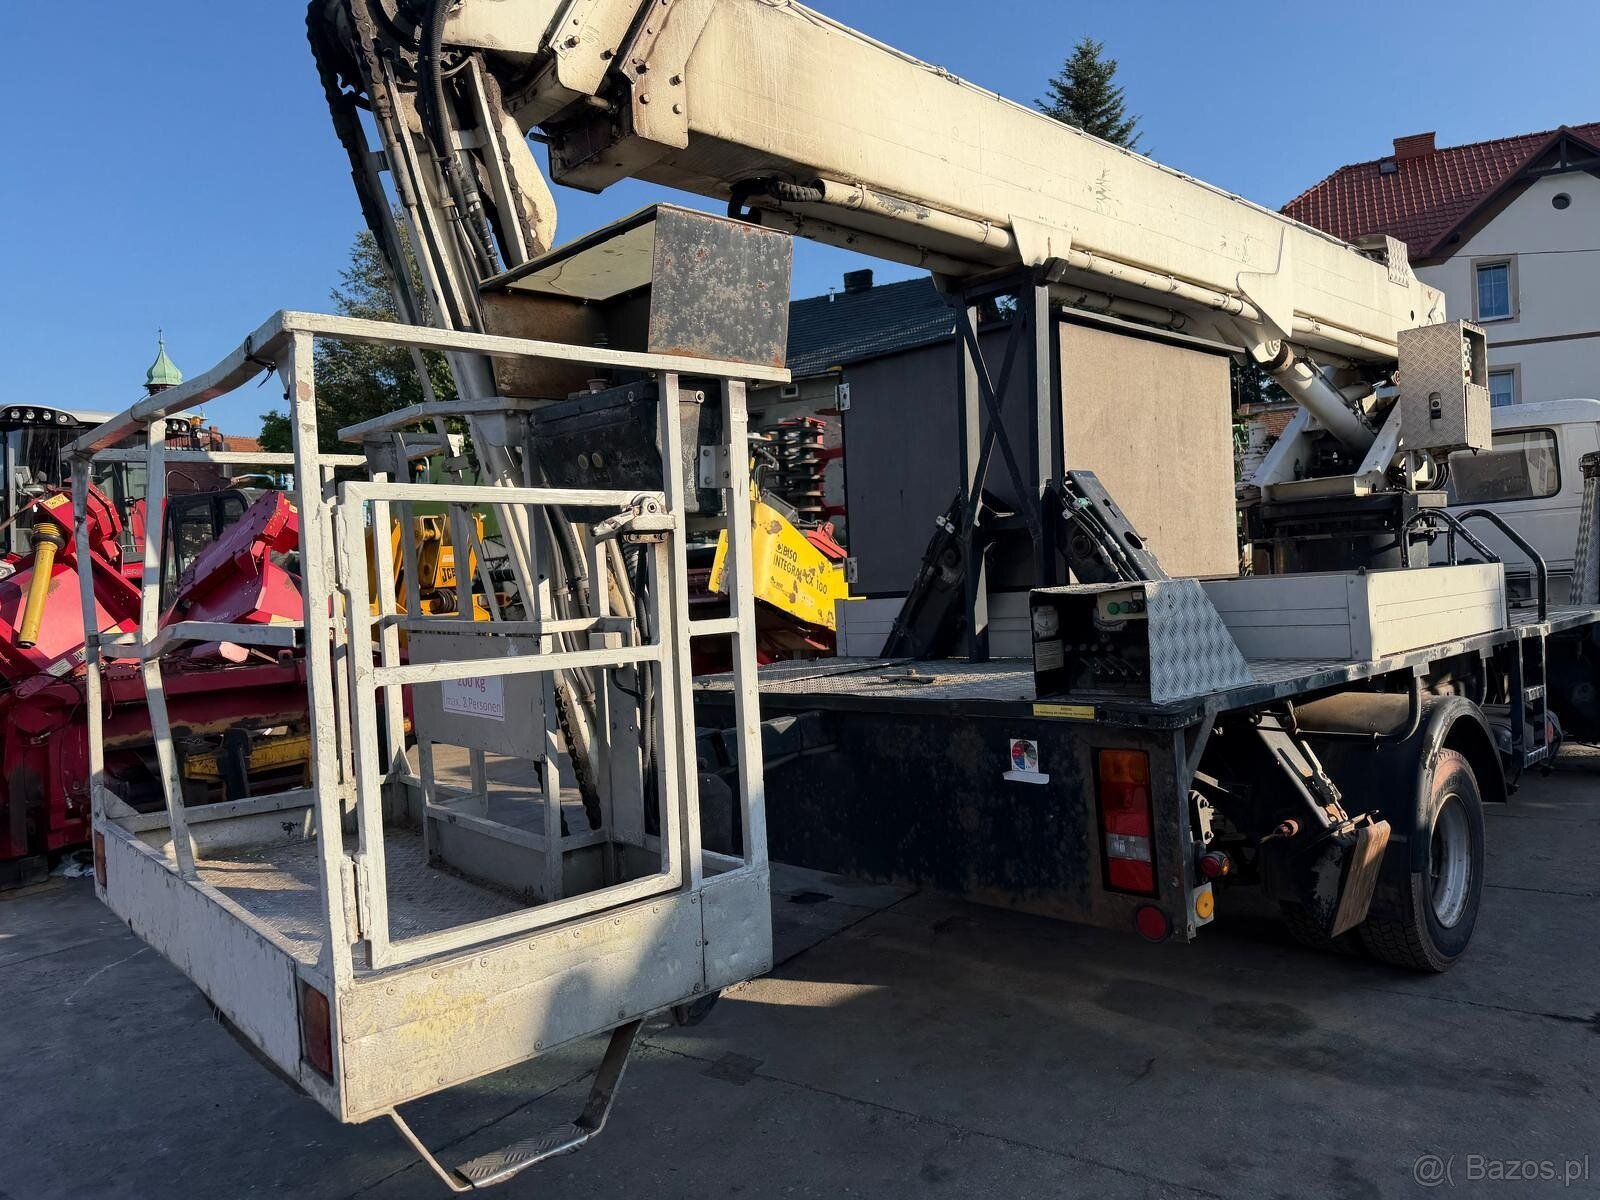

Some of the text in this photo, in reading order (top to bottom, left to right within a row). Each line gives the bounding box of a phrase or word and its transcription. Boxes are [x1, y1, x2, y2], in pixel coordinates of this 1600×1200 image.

[783, 546, 797, 562] BISO
[816, 575, 828, 594] 100
[475, 676, 486, 692] kg
[468, 697, 502, 712] Personen
